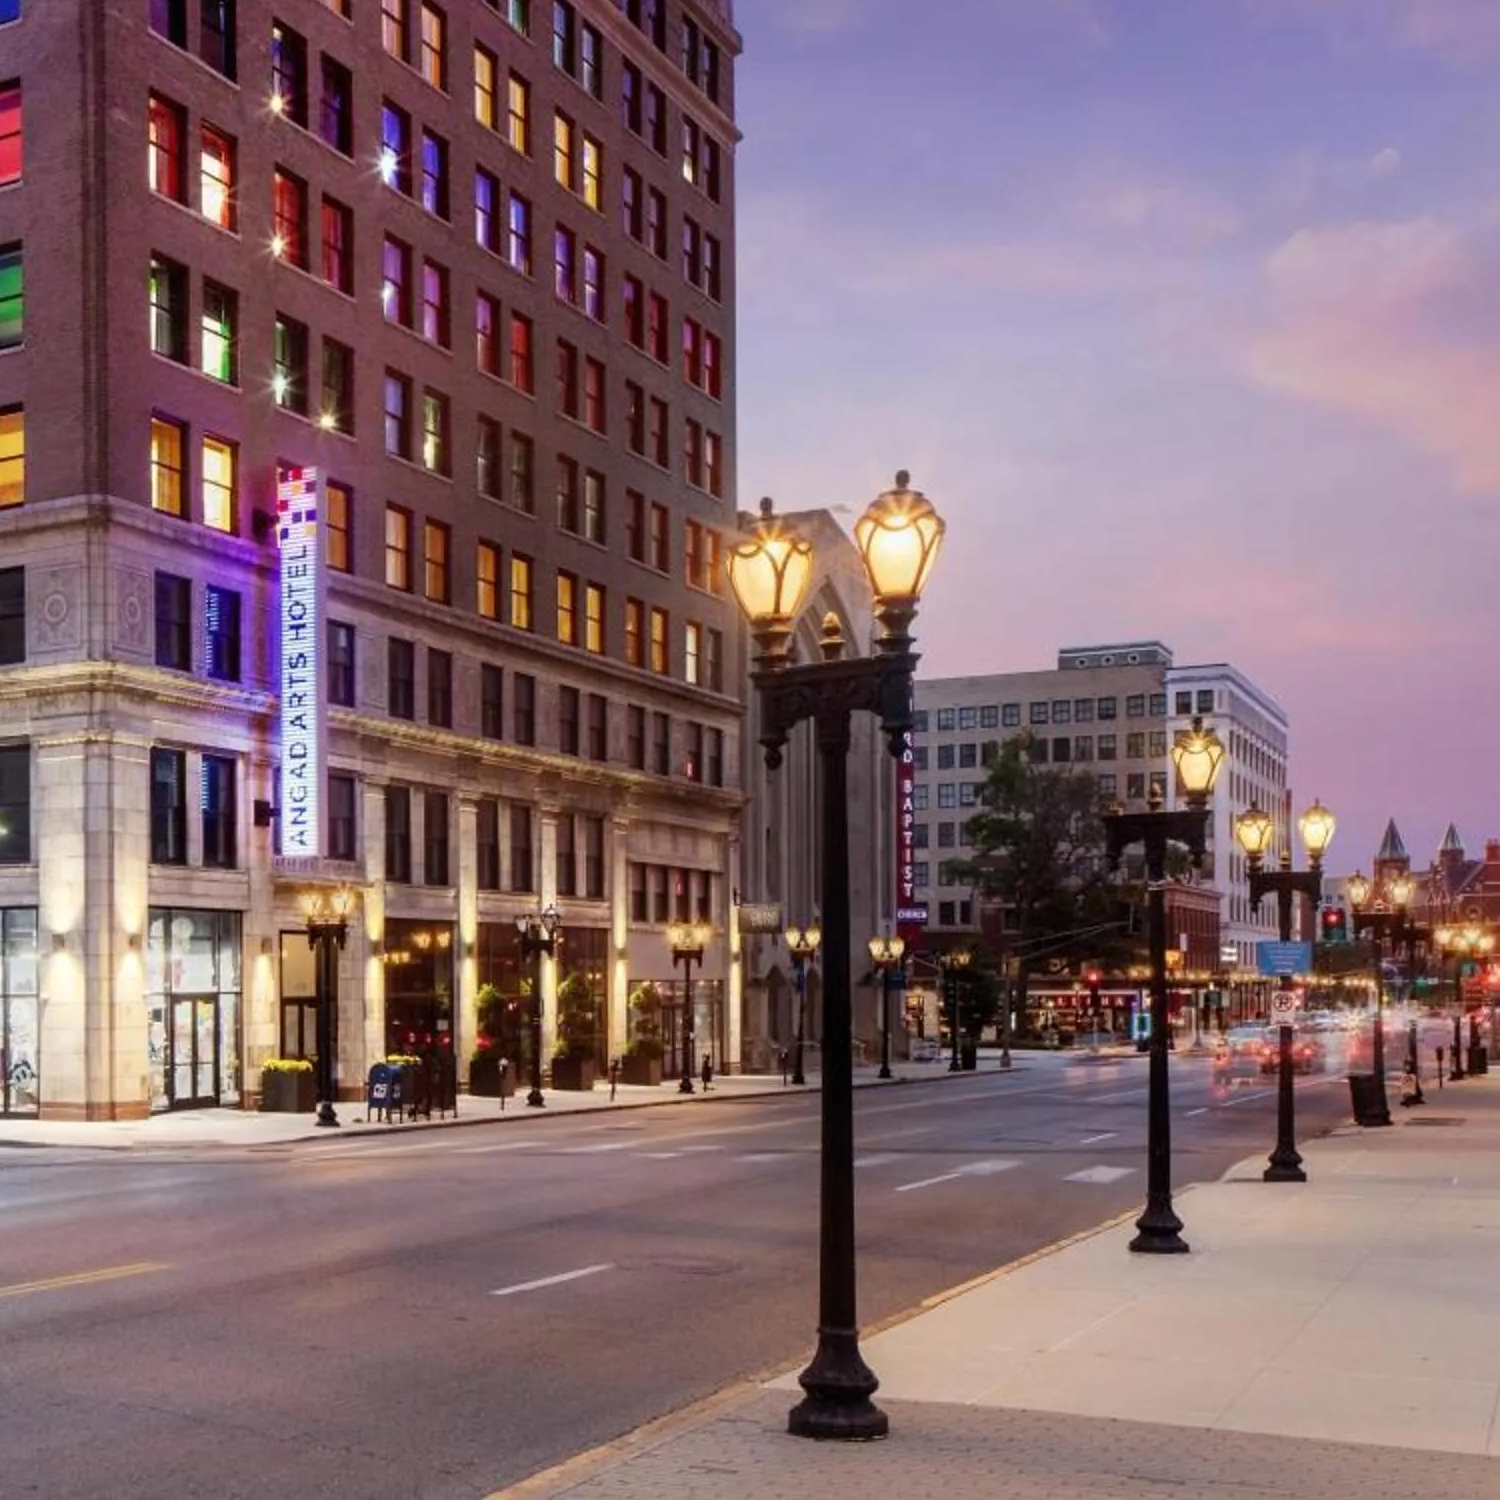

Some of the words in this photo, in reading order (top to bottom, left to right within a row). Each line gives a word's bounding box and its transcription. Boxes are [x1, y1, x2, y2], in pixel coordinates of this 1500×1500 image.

[287, 544, 307, 641] HOTEL
[288, 652, 307, 730] ARTS
[289, 741, 308, 847] ANGAD
[903, 779, 913, 897] BAPTIST
